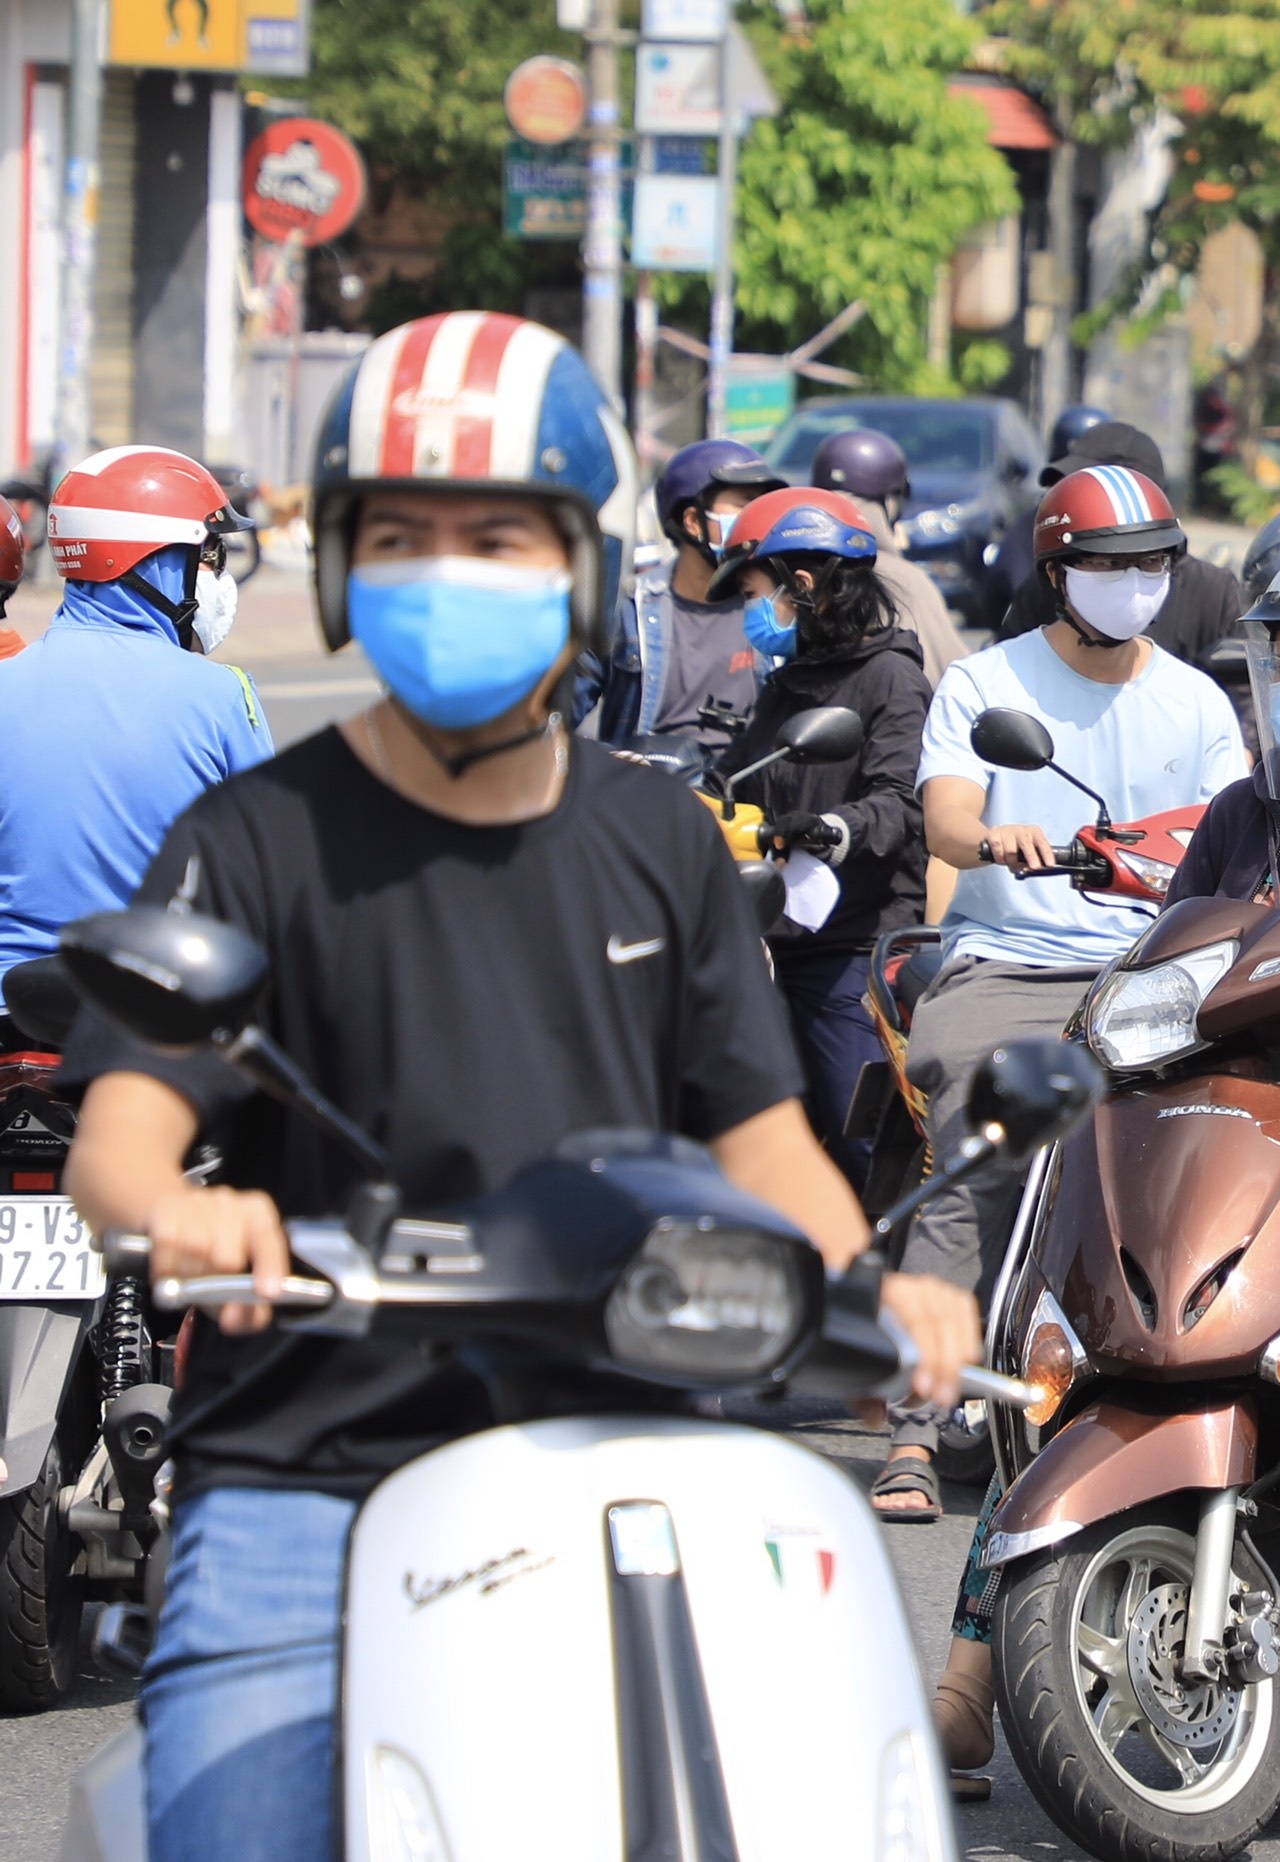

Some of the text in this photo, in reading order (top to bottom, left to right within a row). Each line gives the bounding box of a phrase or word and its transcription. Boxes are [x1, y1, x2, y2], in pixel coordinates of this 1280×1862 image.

[65, 541, 87, 556] PHÁT
[1157, 1104, 1253, 1119] HONDA
[0, 1250, 90, 1291] 7.21
